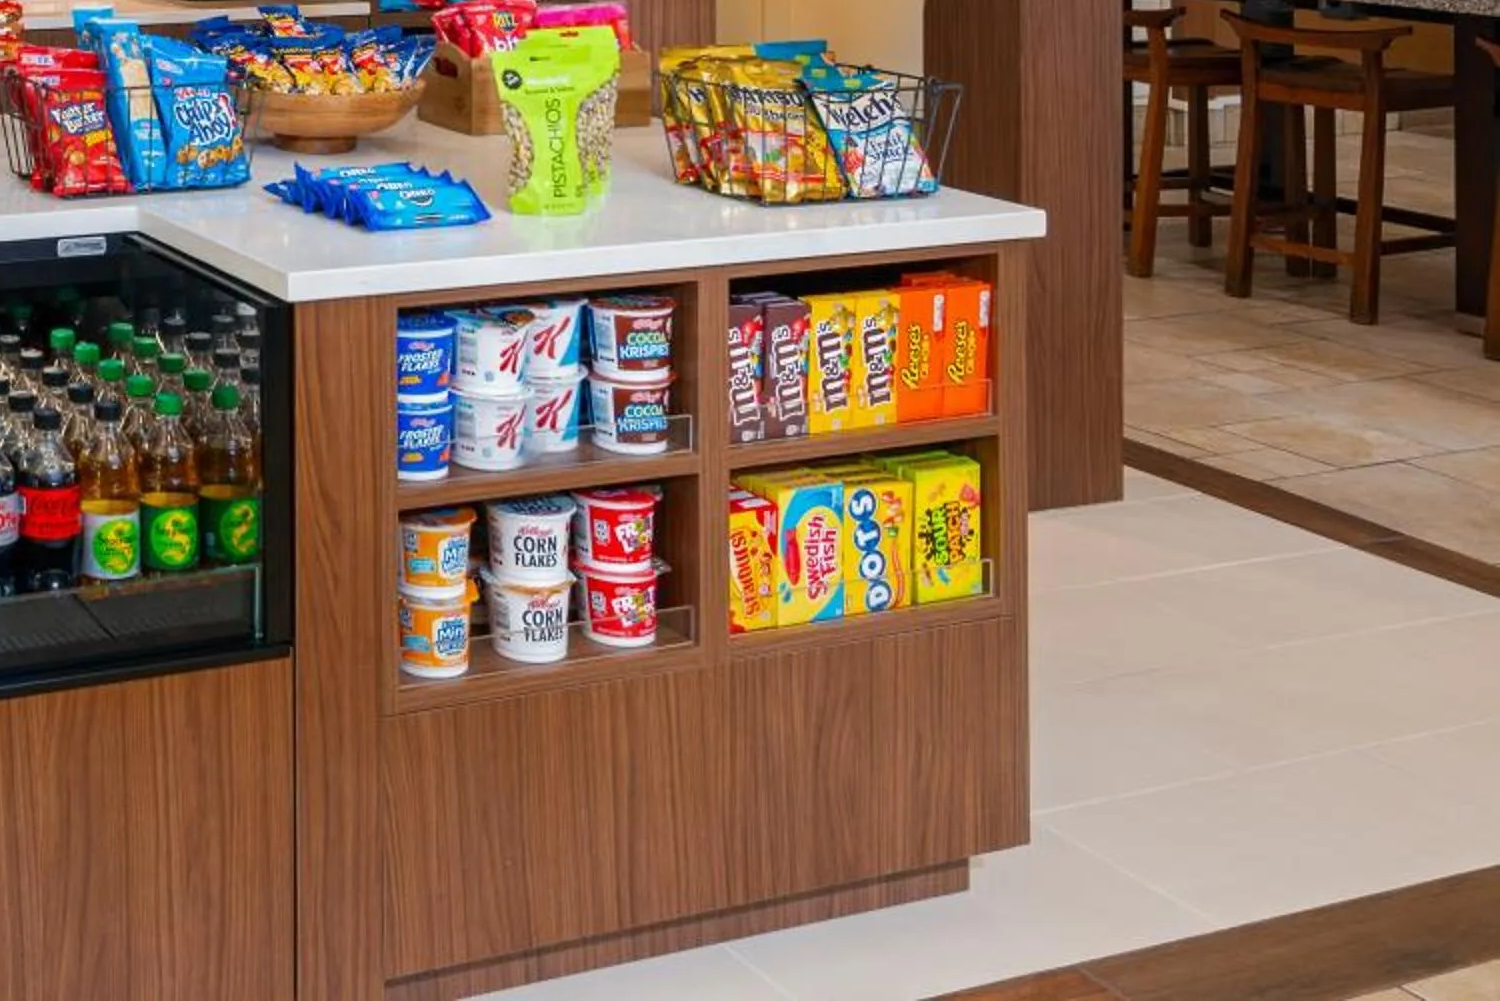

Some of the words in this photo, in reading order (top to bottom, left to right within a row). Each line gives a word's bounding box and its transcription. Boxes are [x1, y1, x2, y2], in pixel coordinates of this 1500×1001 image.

[545, 98, 567, 199] PISTACHIOS
[513, 535, 558, 552] CORN
[515, 553, 558, 568] FLAKES
[803, 514, 825, 601] Swedish
[821, 528, 837, 577] Fish
[851, 490, 889, 609] DOTS
[522, 607, 563, 627] CORN
[524, 626, 564, 643] FLAKES
